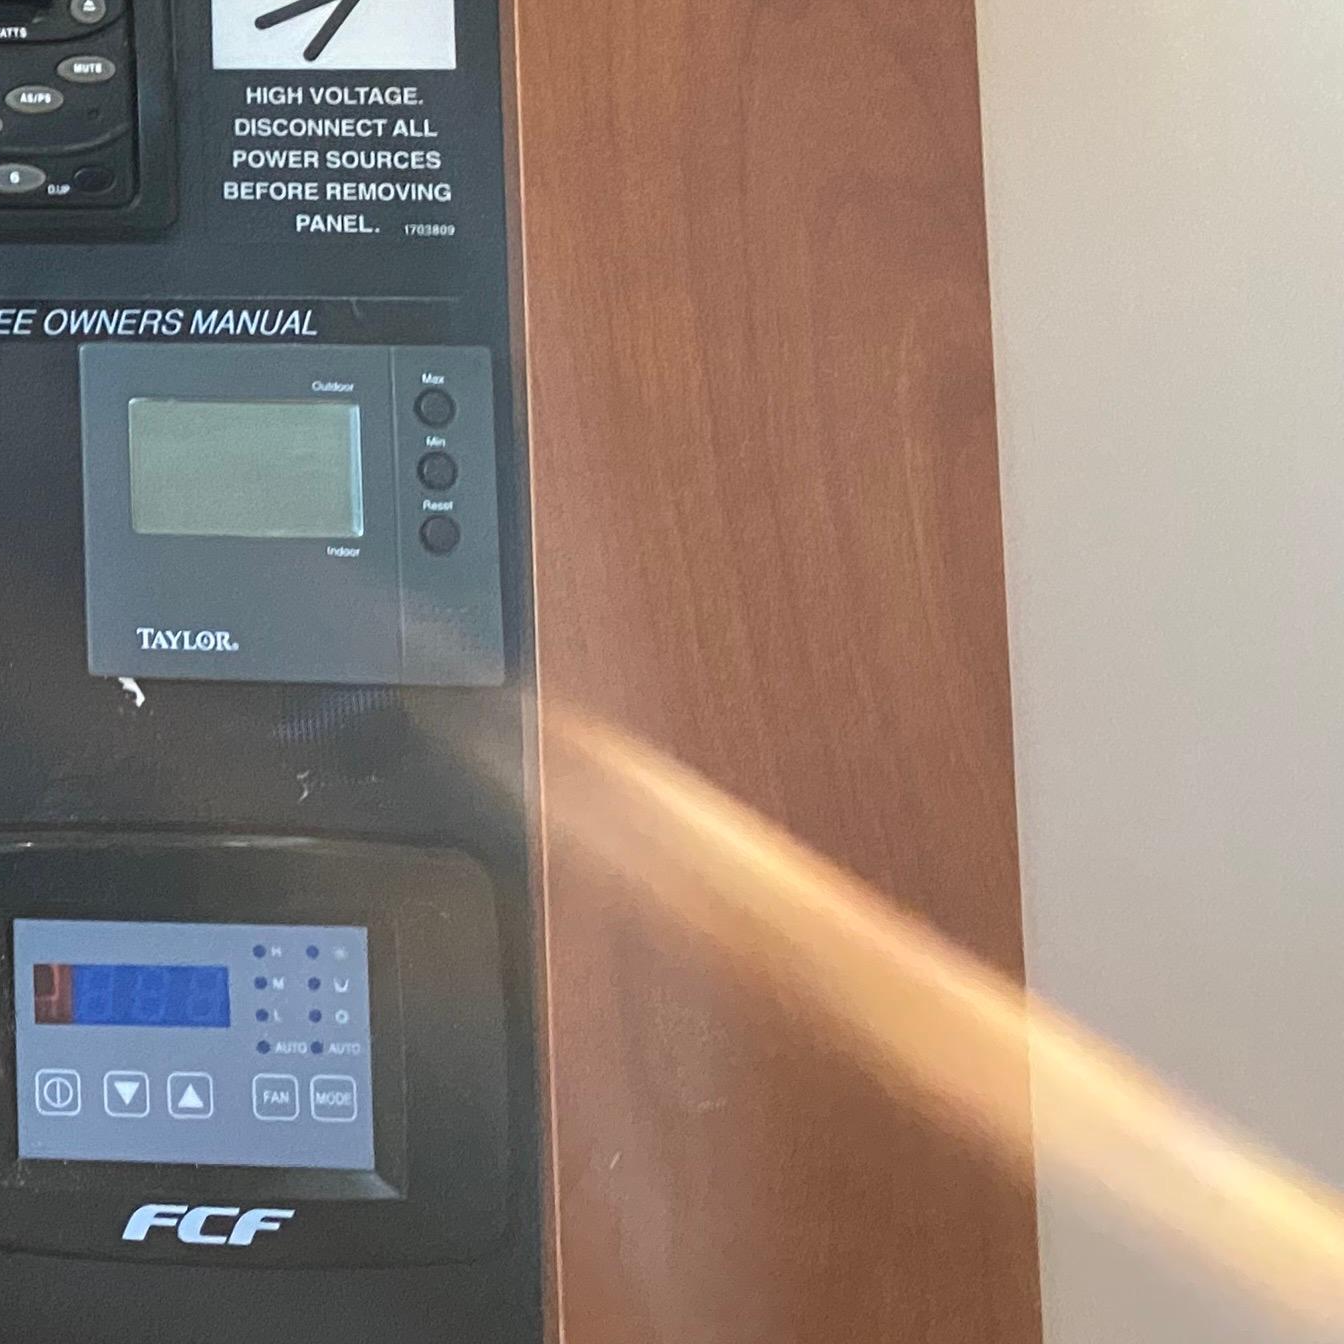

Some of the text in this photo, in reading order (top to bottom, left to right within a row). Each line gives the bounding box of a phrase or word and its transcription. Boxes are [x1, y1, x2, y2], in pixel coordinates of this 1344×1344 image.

[74, 64, 102, 73] MUTE
[246, 87, 424, 105] HIGH VOLTAGE.
[234, 118, 438, 138] DISCONNECT ALL
[232, 151, 441, 170] POWER SOURCES
[223, 182, 452, 202] BEFORE REMOVING
[296, 215, 381, 234] PANEL.
[43, 309, 184, 336] OWNERS
[189, 310, 318, 336] MANUAL
[422, 374, 445, 384] Max
[312, 381, 354, 392] Outdoor
[426, 437, 446, 447] Min
[423, 500, 453, 511] Reset
[327, 546, 360, 557] Indoor
[276, 1043, 307, 1054] AUTO
[328, 1044, 360, 1054] AUTO
[263, 1090, 289, 1104] FAN
[316, 1092, 352, 1105] MODE
[122, 1203, 296, 1246] FCF
